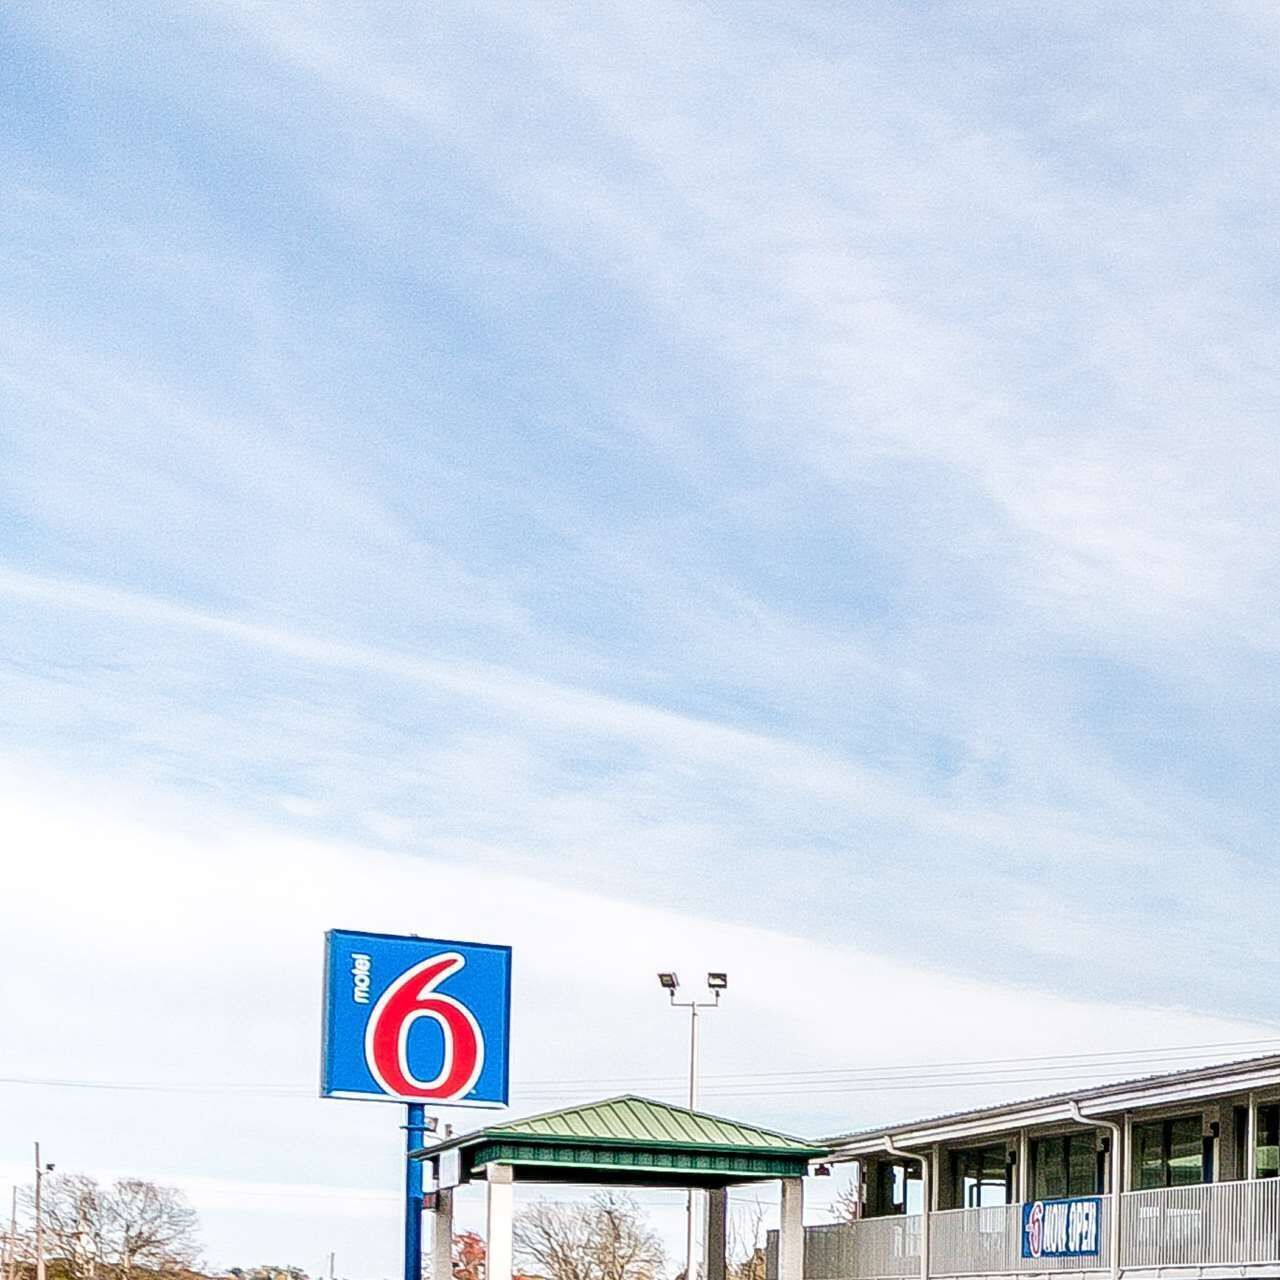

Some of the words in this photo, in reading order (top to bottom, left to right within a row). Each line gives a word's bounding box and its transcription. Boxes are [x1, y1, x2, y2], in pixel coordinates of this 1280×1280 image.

[351, 953, 371, 1003] motel
[365, 952, 485, 1100] 6
[1043, 1203, 1068, 1253] NOW
[1068, 1201, 1097, 1253] OPEN
